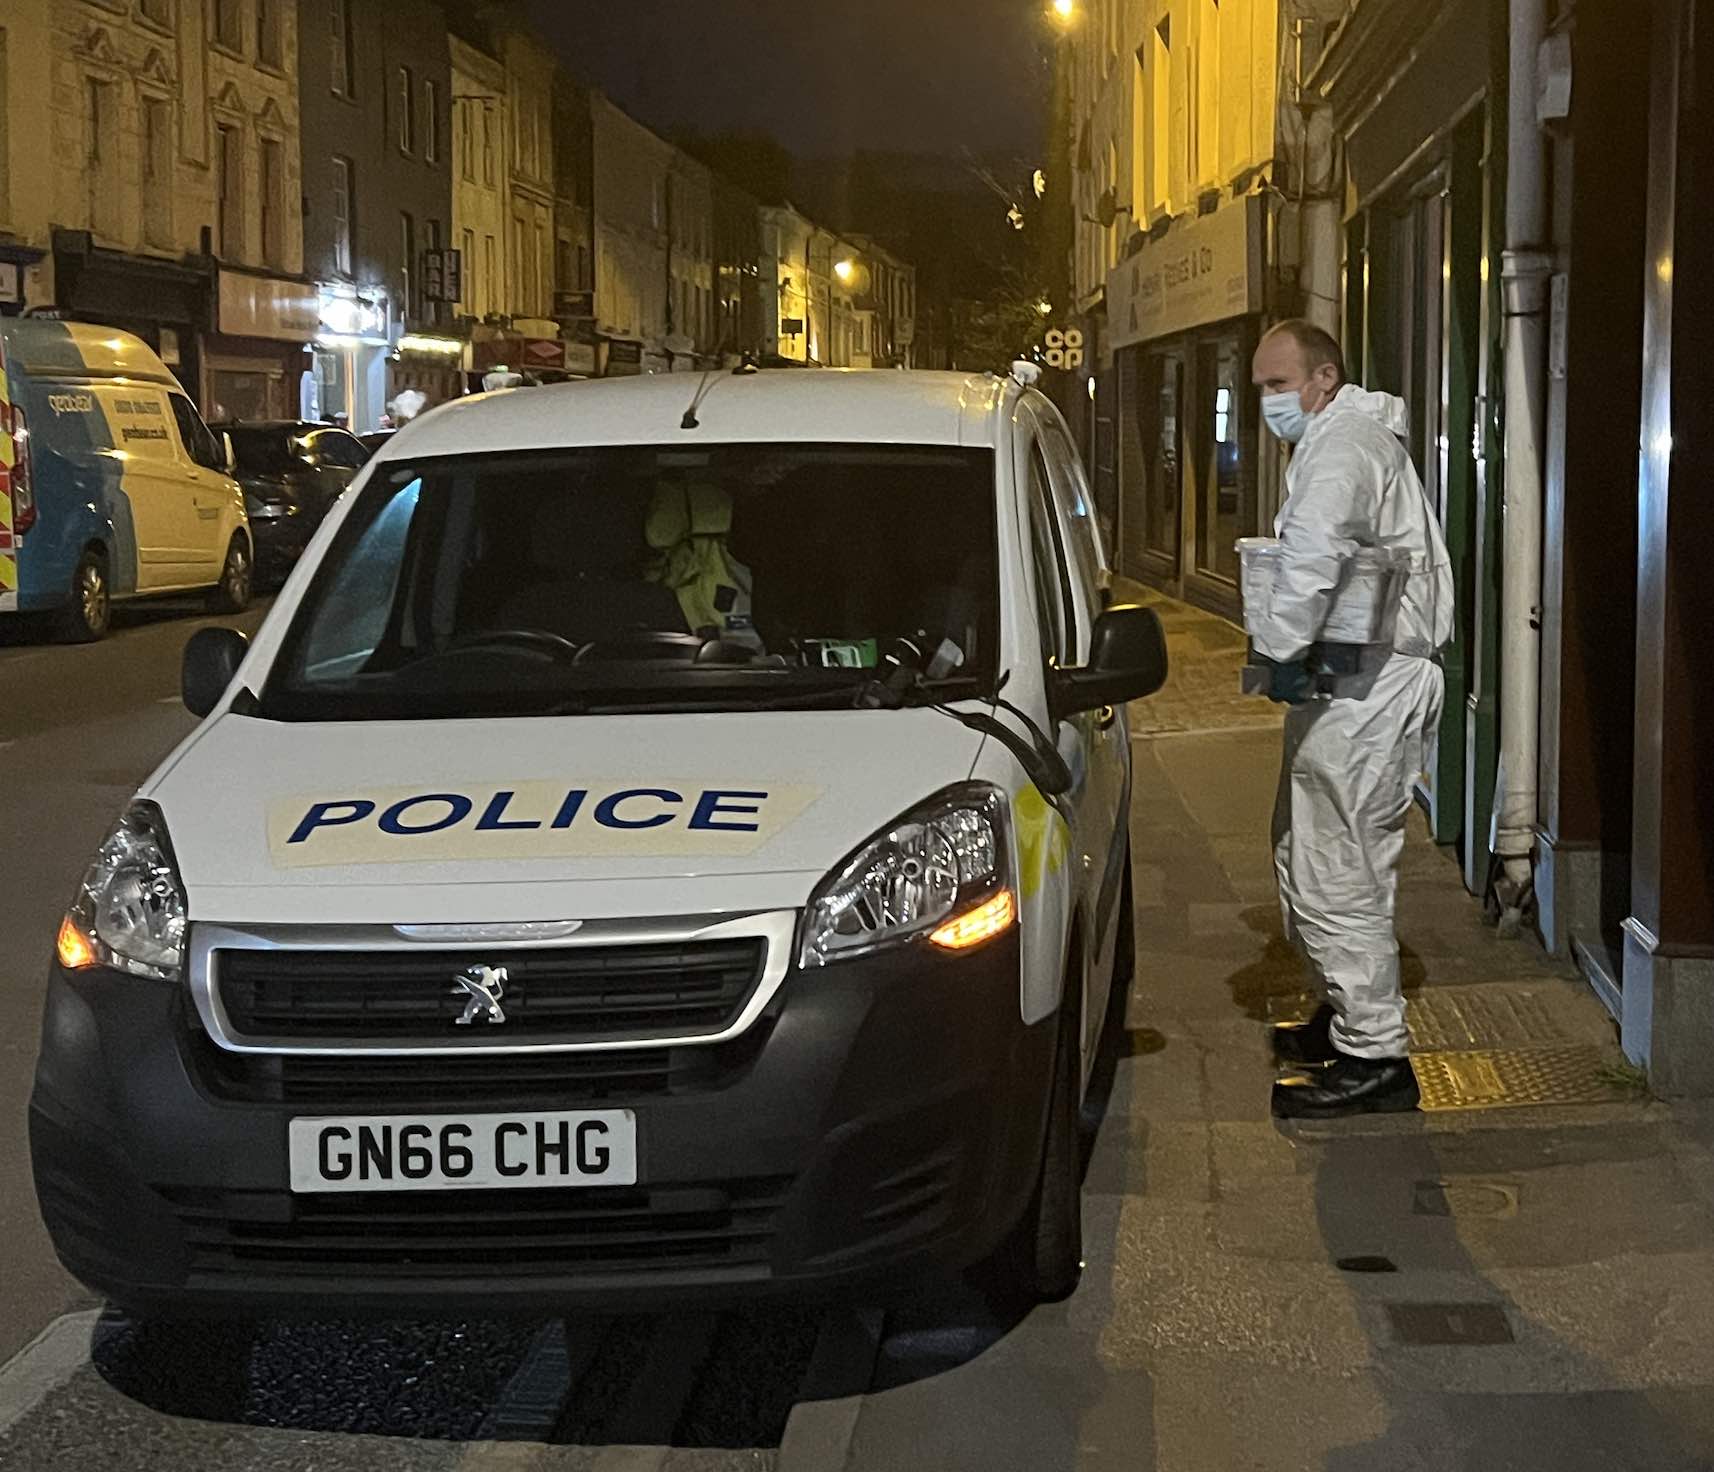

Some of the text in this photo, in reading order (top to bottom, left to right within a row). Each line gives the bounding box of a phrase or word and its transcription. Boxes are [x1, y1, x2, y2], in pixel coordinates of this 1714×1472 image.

[286, 789, 769, 843] POLICE
[319, 1120, 610, 1180] GN66 CHG
